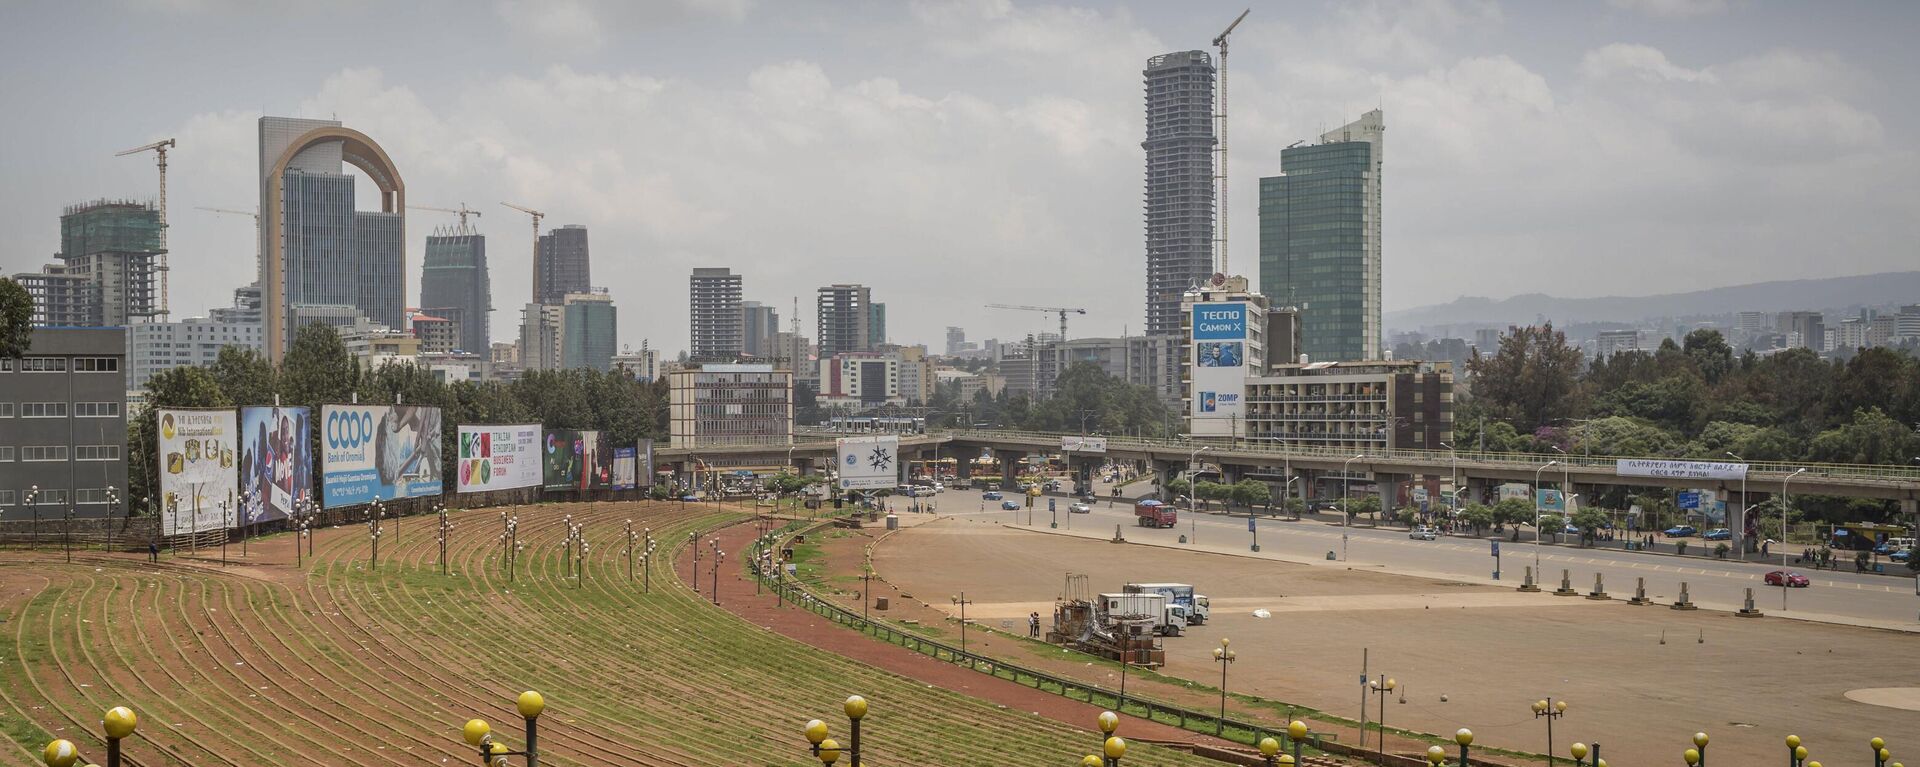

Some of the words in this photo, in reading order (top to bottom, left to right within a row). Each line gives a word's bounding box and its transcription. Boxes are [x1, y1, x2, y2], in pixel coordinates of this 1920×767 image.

[1201, 311, 1240, 320] TECNO
[1233, 322, 1241, 331] X
[1218, 393, 1239, 402] 20MP
[328, 452, 340, 463] Bank
[346, 451, 365, 463] Oromia
[493, 455, 514, 465] BUSINESS
